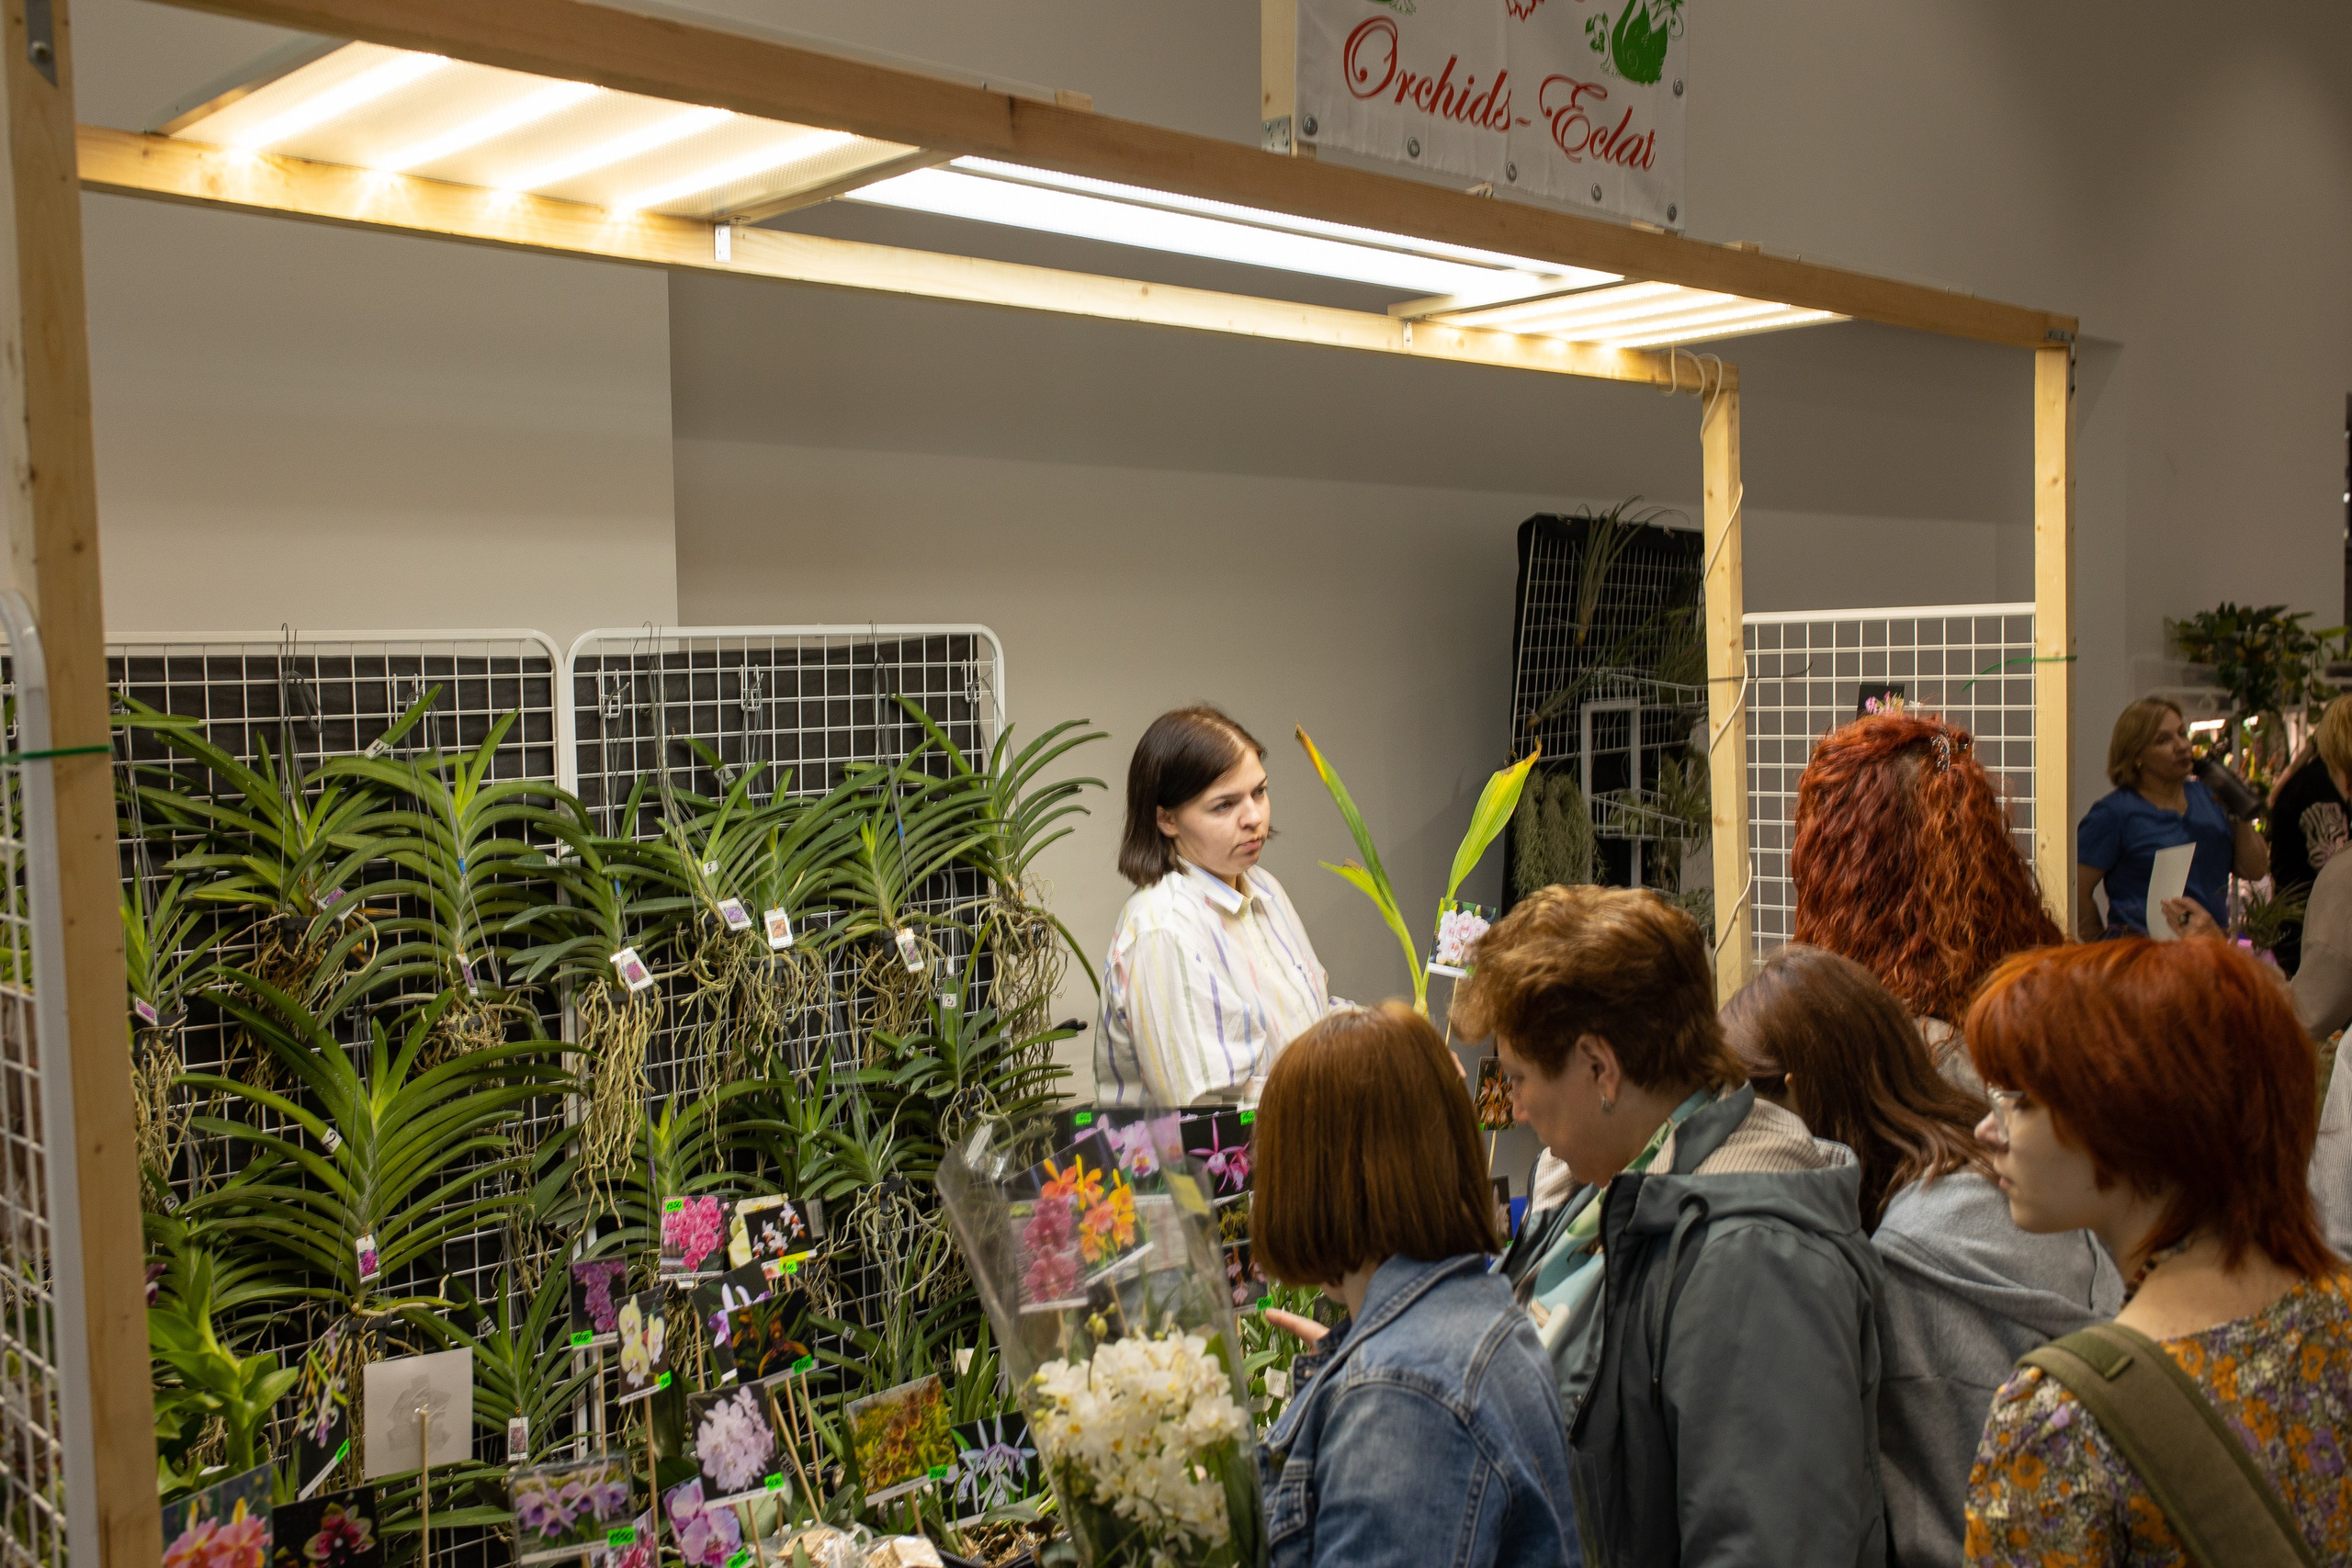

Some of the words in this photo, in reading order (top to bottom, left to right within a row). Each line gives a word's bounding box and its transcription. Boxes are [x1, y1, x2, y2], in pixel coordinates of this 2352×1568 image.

[718, 769, 733, 782] 2
[323, 1132, 337, 1148] 2
[164, 1197, 176, 1211] 3
